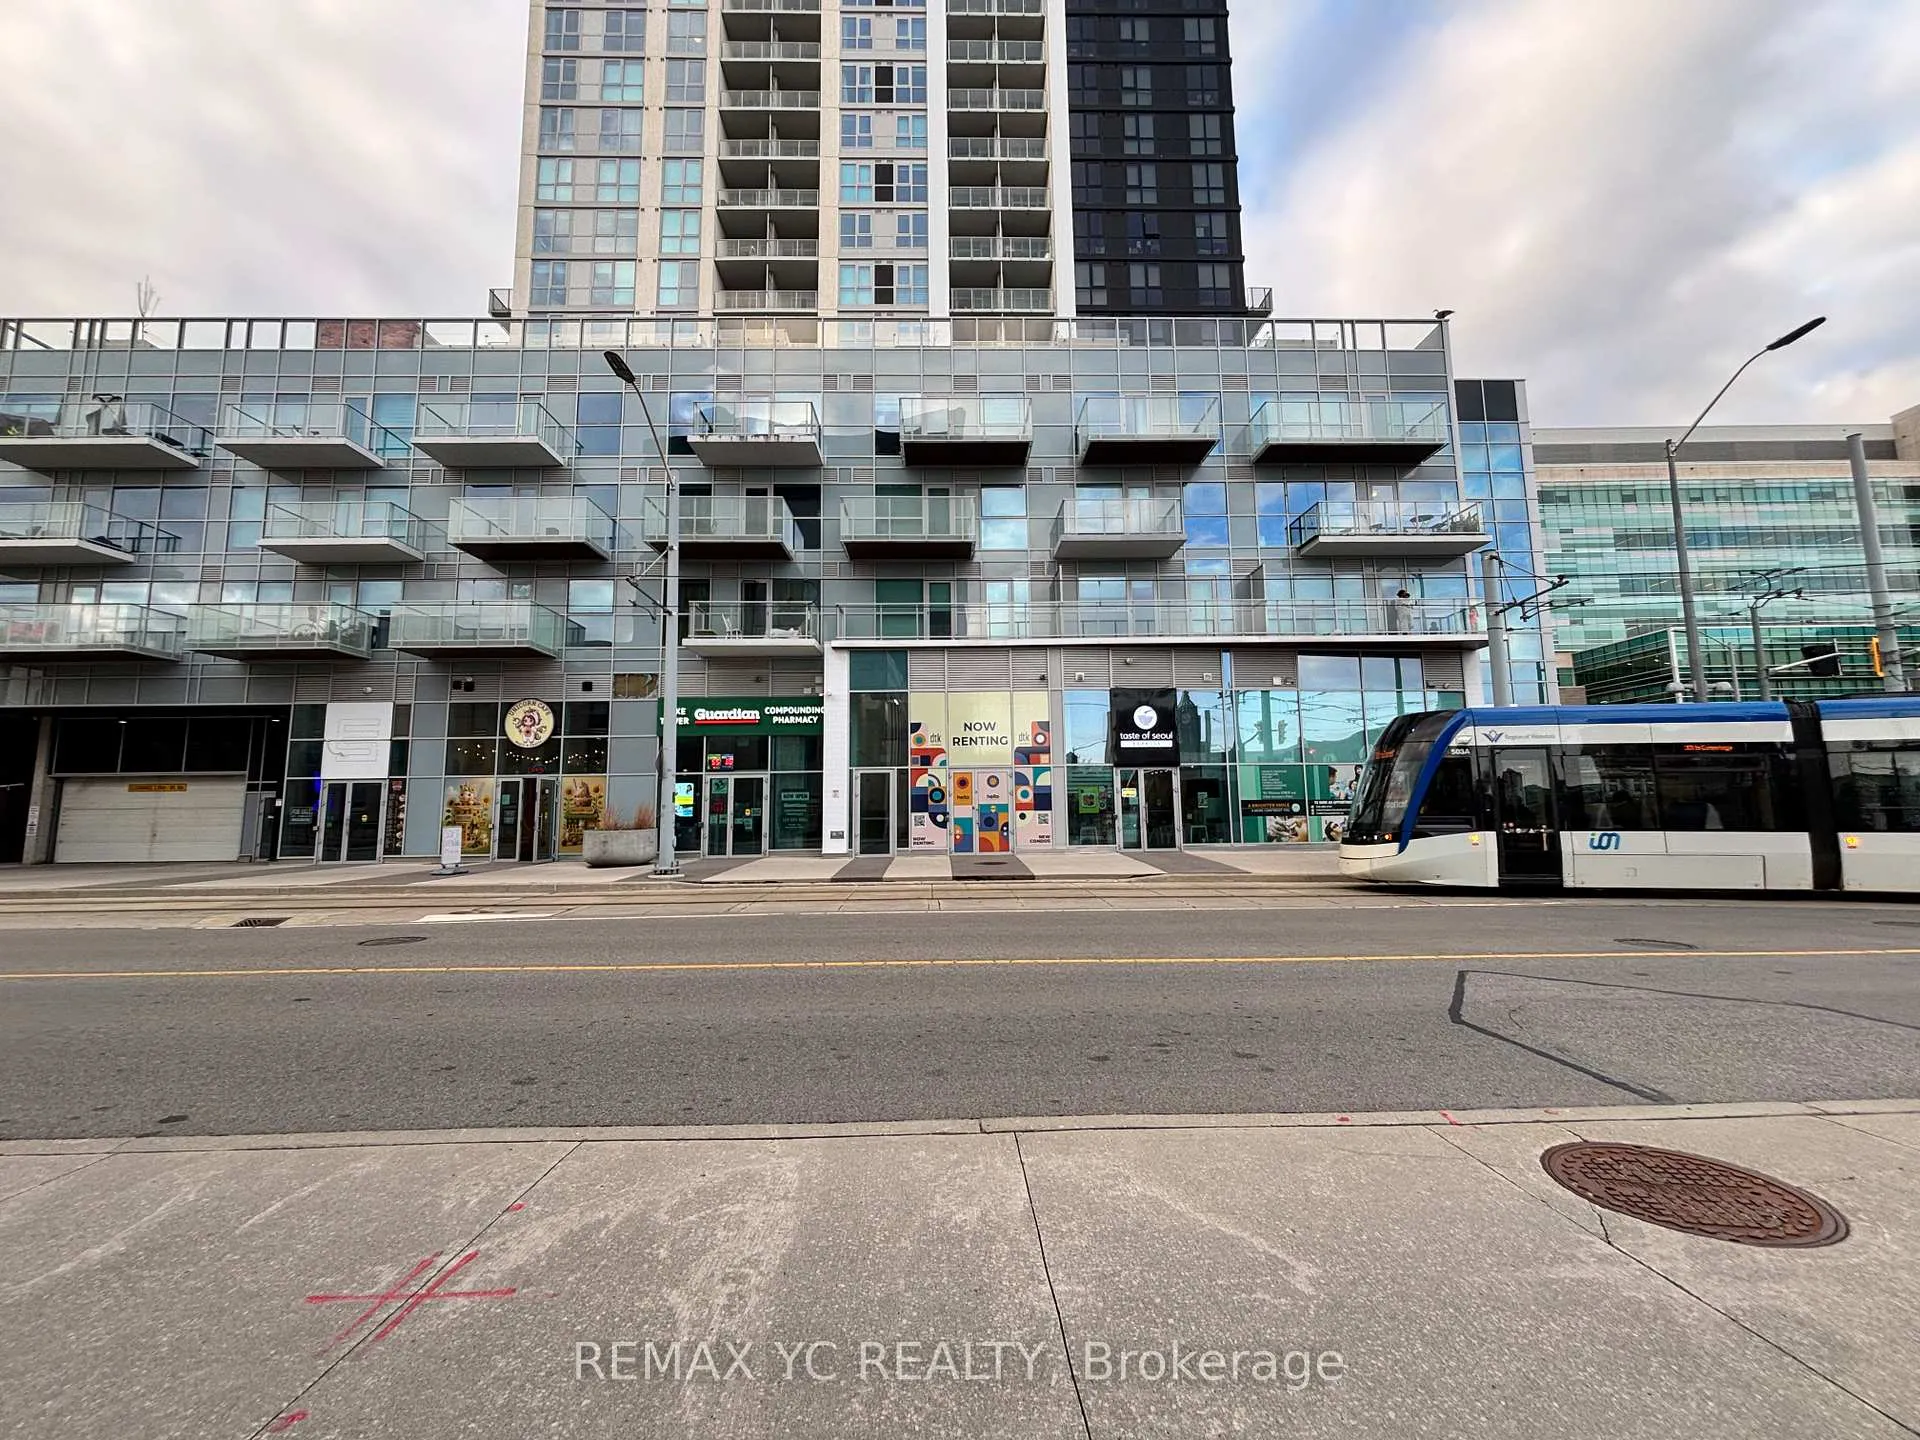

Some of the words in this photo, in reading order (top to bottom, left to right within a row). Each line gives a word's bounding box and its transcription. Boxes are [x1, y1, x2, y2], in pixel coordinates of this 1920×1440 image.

[509, 700, 536, 716] UNICORN
[694, 708, 761, 720] Guardian
[659, 717, 690, 726] TER
[772, 715, 819, 724] PHARMACY
[964, 722, 996, 732] NOW
[1141, 731, 1151, 740] of
[1152, 731, 1173, 740] seoul
[953, 736, 1008, 746] RENTING
